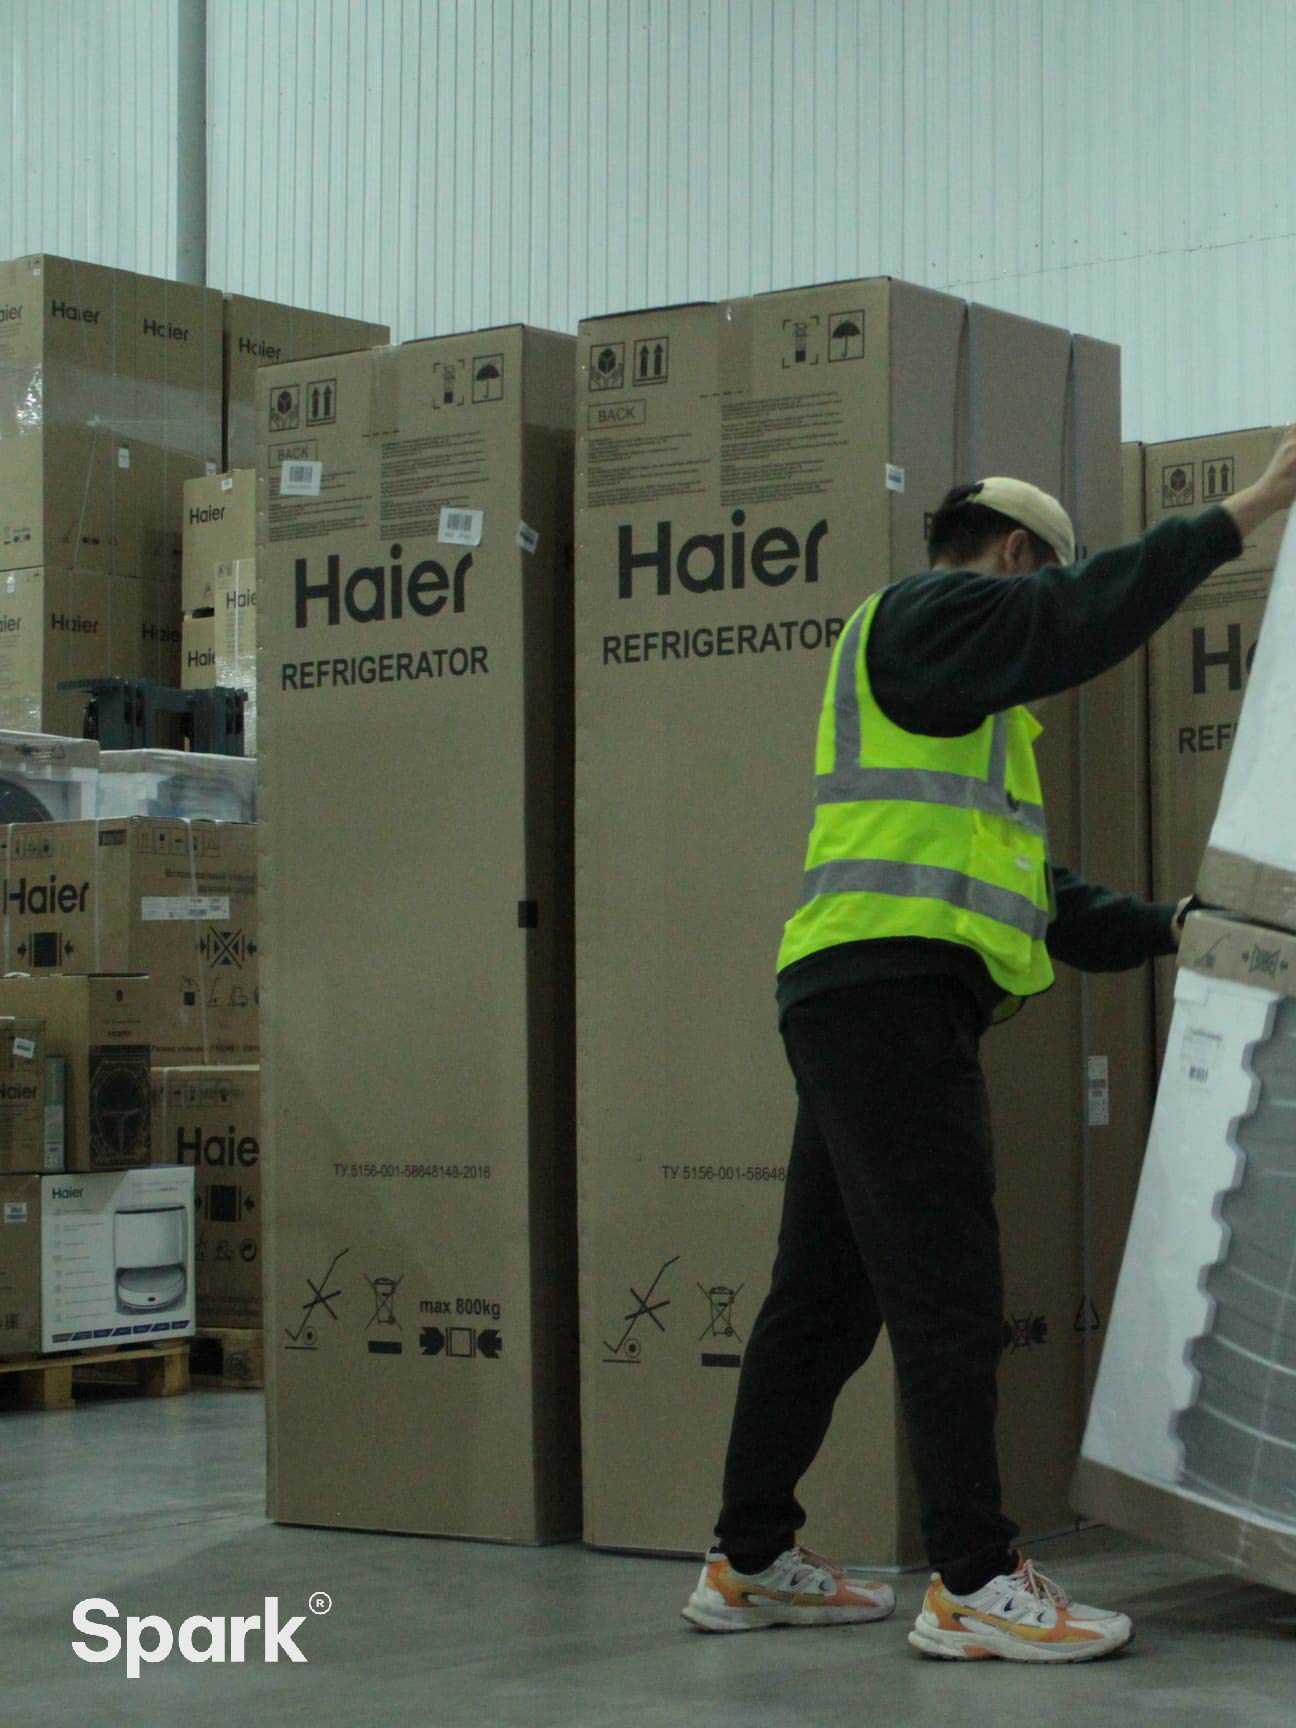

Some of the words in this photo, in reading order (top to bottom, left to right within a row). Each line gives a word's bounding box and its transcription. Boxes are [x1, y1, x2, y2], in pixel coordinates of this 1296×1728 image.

[51, 299, 100, 325] Haier
[598, 407, 635, 424] BACK
[278, 446, 308, 462] BACK
[189, 504, 225, 525] Haier
[618, 509, 828, 599] Haier
[295, 544, 473, 629] Haier
[51, 613, 99, 634] Haier
[603, 618, 845, 665] REFRIGERATOR
[188, 650, 215, 668] Hai
[281, 646, 489, 691] REFRIGERATOR
[1192, 623, 1257, 694] H
[1179, 722, 1237, 754] REF
[4, 875, 90, 915] Haier
[52, 1186, 84, 1200] Haier
[419, 1300, 451, 1315] max
[456, 1298, 501, 1320] 800kg
